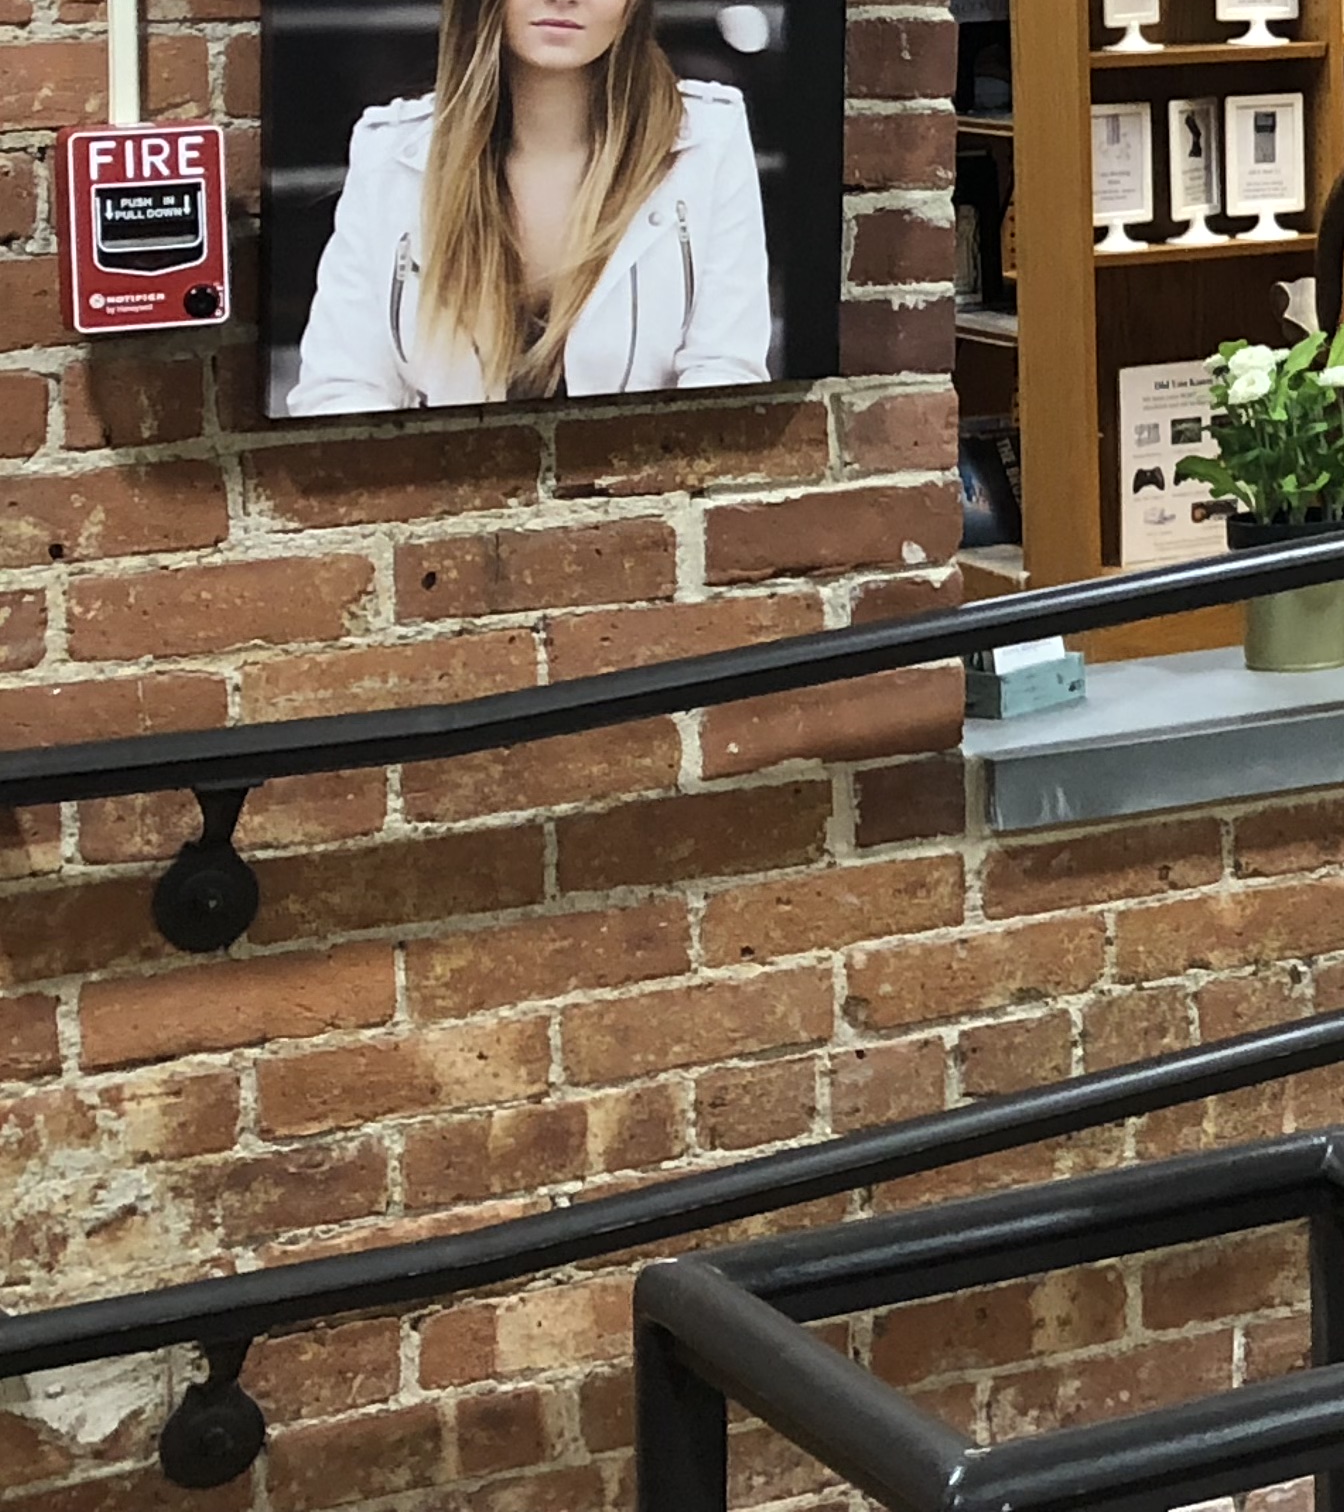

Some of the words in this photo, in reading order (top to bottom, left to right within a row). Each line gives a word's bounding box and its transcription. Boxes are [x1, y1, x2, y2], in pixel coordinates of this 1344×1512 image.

[88, 136, 205, 181] FIRE
[120, 197, 153, 208] PUSH
[163, 195, 175, 206] IN
[115, 209, 145, 220] PULL
[146, 207, 183, 219] DOWN
